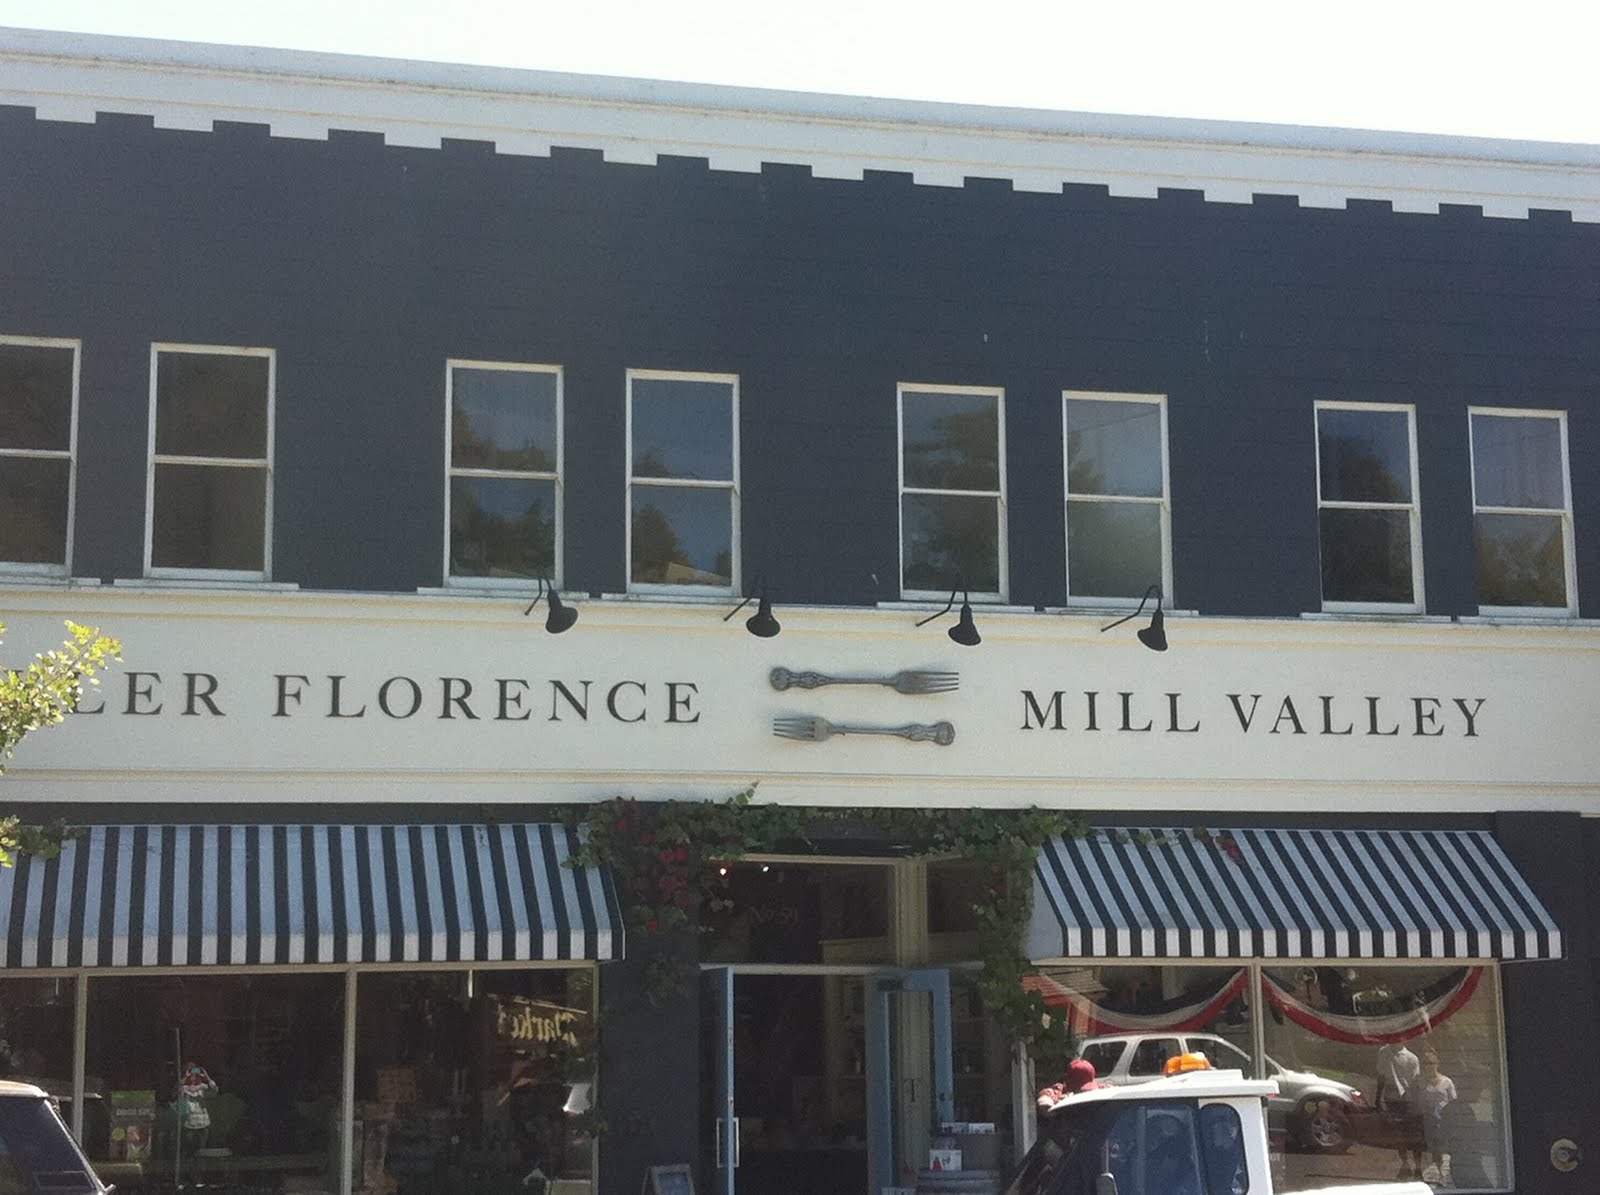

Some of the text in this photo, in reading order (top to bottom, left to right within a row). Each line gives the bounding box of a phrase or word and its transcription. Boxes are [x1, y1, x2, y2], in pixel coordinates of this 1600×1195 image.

[272, 673, 702, 724] FLORENCE
[1020, 689, 1487, 738] MILL VALLEY
